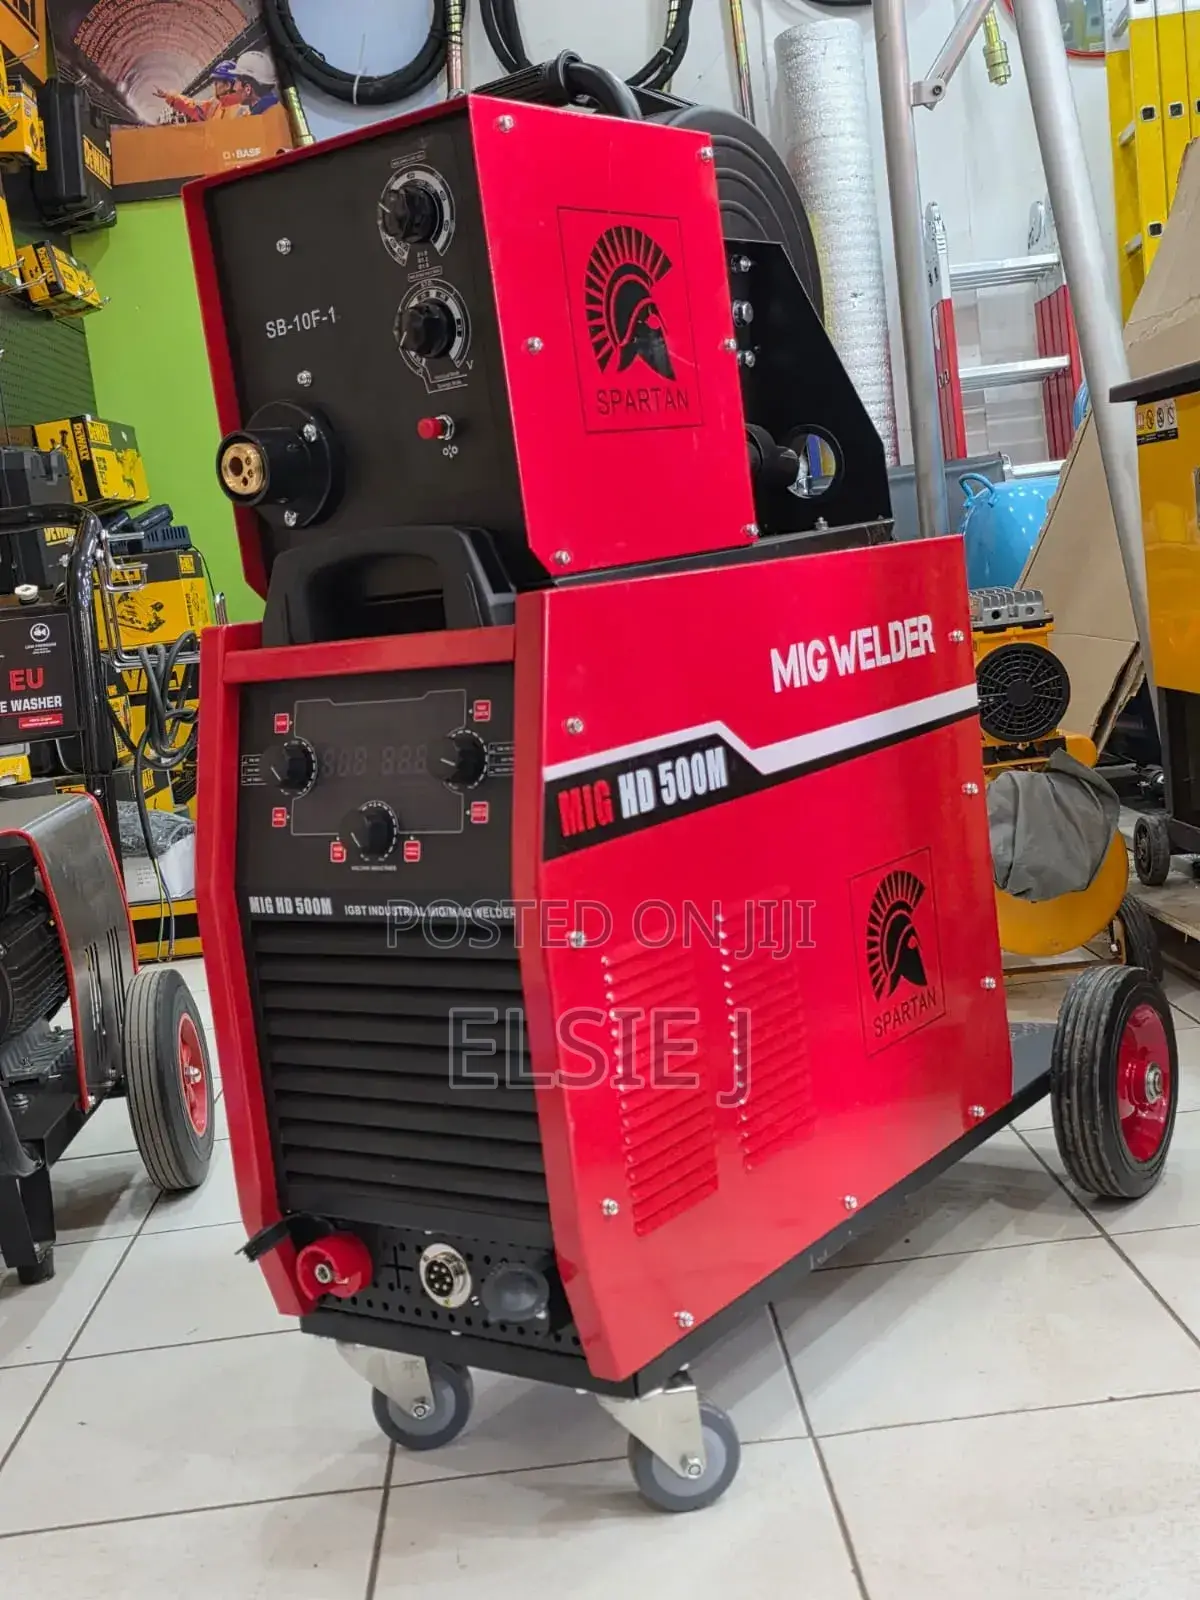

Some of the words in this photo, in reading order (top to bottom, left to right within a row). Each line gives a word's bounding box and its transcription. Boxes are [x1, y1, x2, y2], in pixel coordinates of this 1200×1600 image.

[235, 147, 262, 159] BASF
[265, 306, 336, 339] SB-10F-1
[597, 387, 689, 416] SPARTAN
[770, 637, 828, 693] MIG
[832, 615, 936, 677] WELDER
[9, 667, 44, 691] EU
[11, 695, 62, 712] WASHER
[557, 780, 614, 837] MIG
[618, 767, 656, 819] HD
[658, 746, 729, 806] 500M
[248, 896, 274, 914] MIG
[275, 896, 294, 915] HD
[294, 897, 333, 916] 500M
[344, 904, 367, 917] IGBT
[873, 986, 936, 1037] SPARTAN
